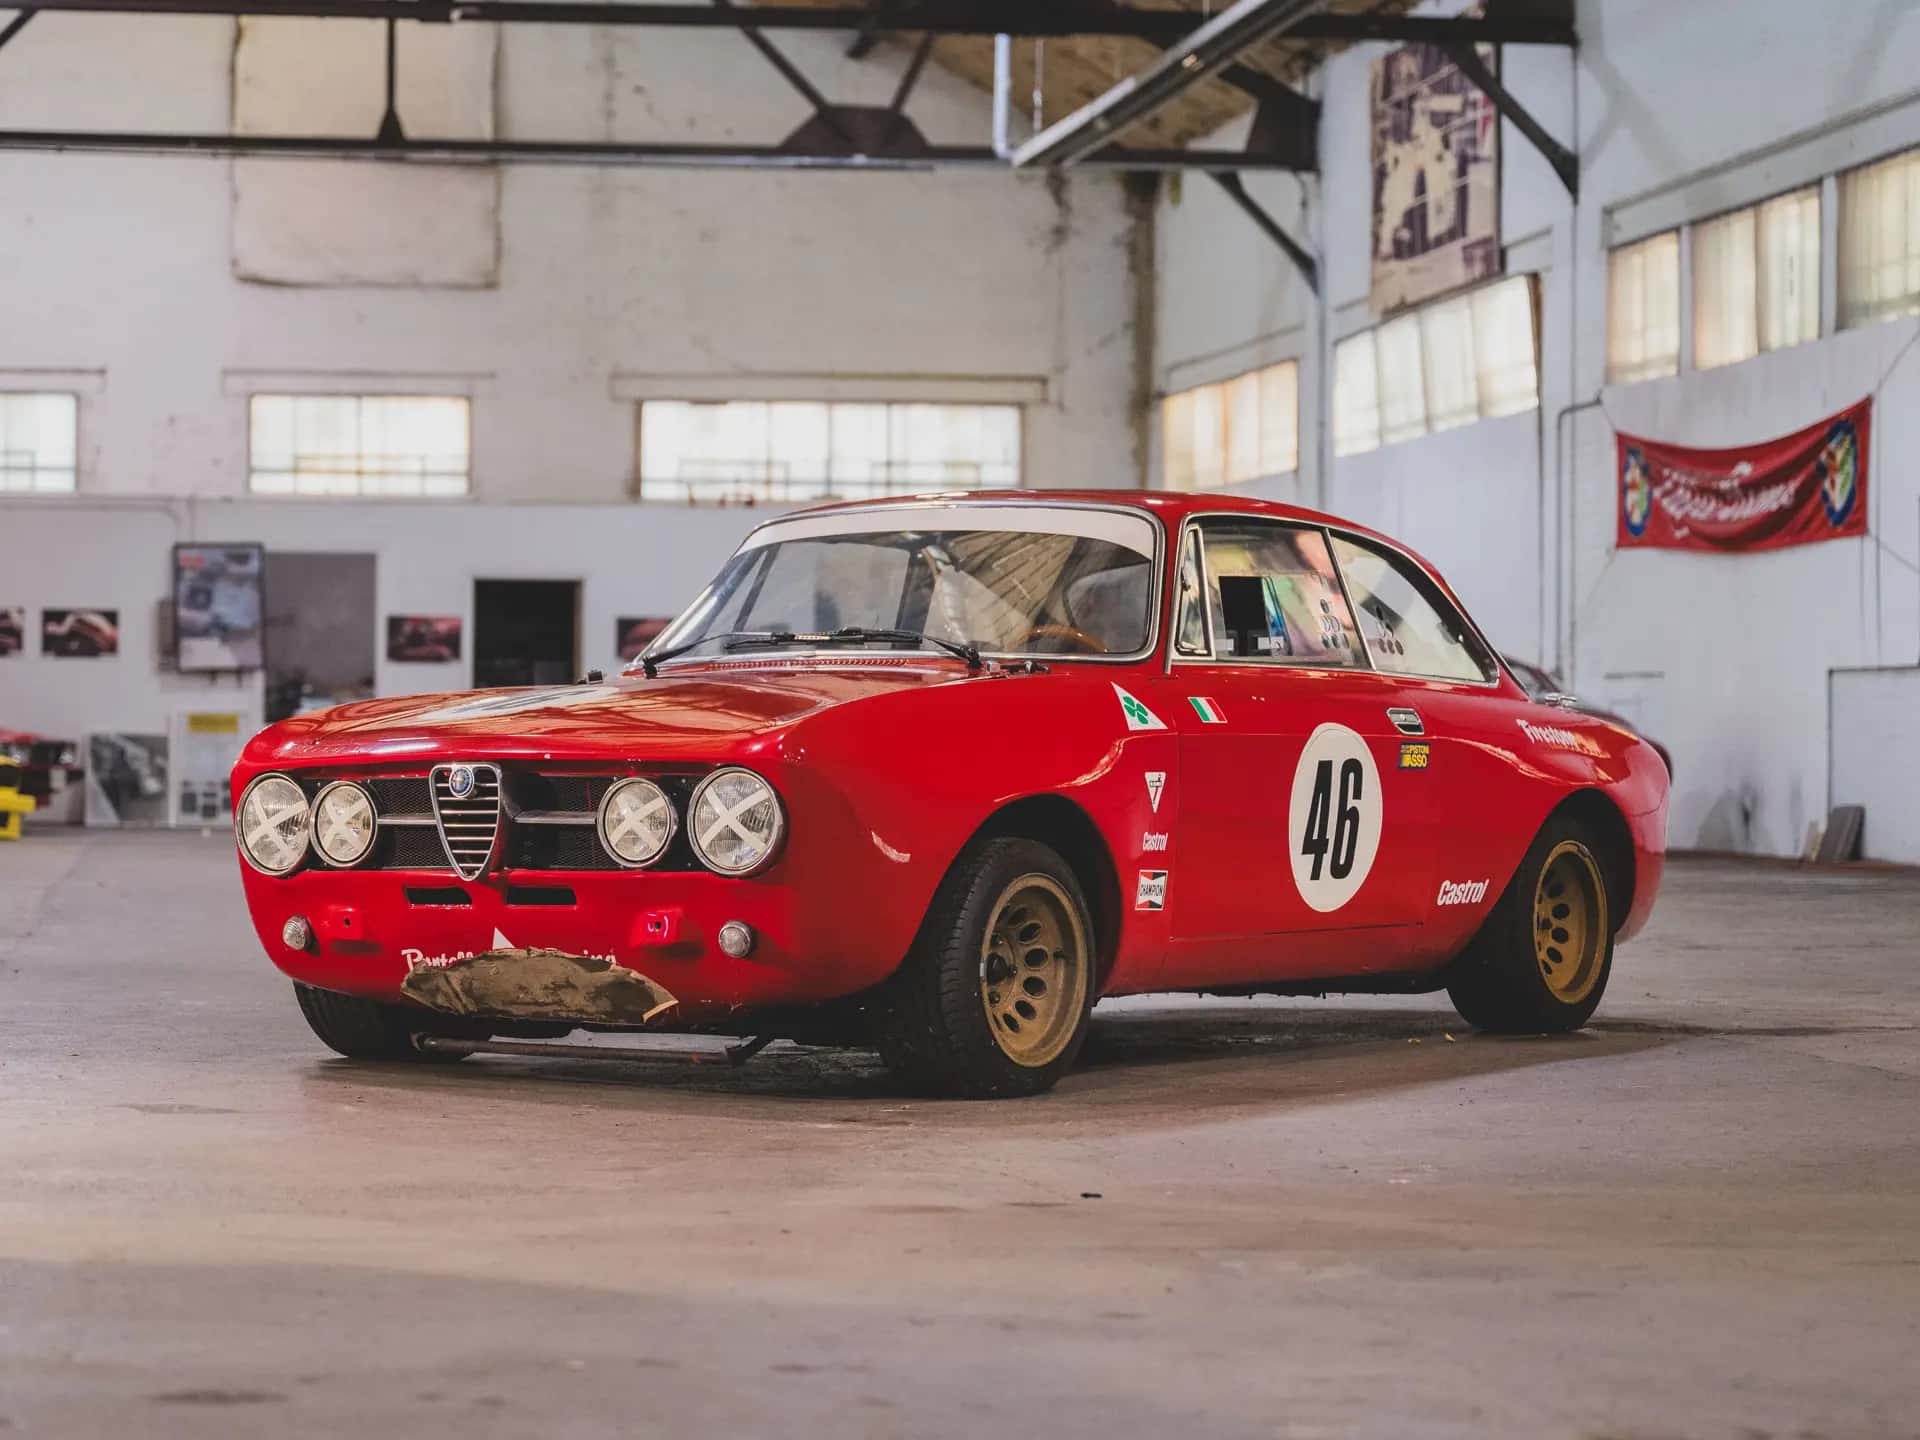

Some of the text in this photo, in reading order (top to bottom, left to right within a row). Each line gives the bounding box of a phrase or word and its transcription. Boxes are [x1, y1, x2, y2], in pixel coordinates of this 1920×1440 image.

[1301, 758, 1364, 881] 46
[1142, 831, 1168, 851] Castrol
[1139, 884, 1165, 897] CHAMPION
[1436, 878, 1490, 906] Castrol
